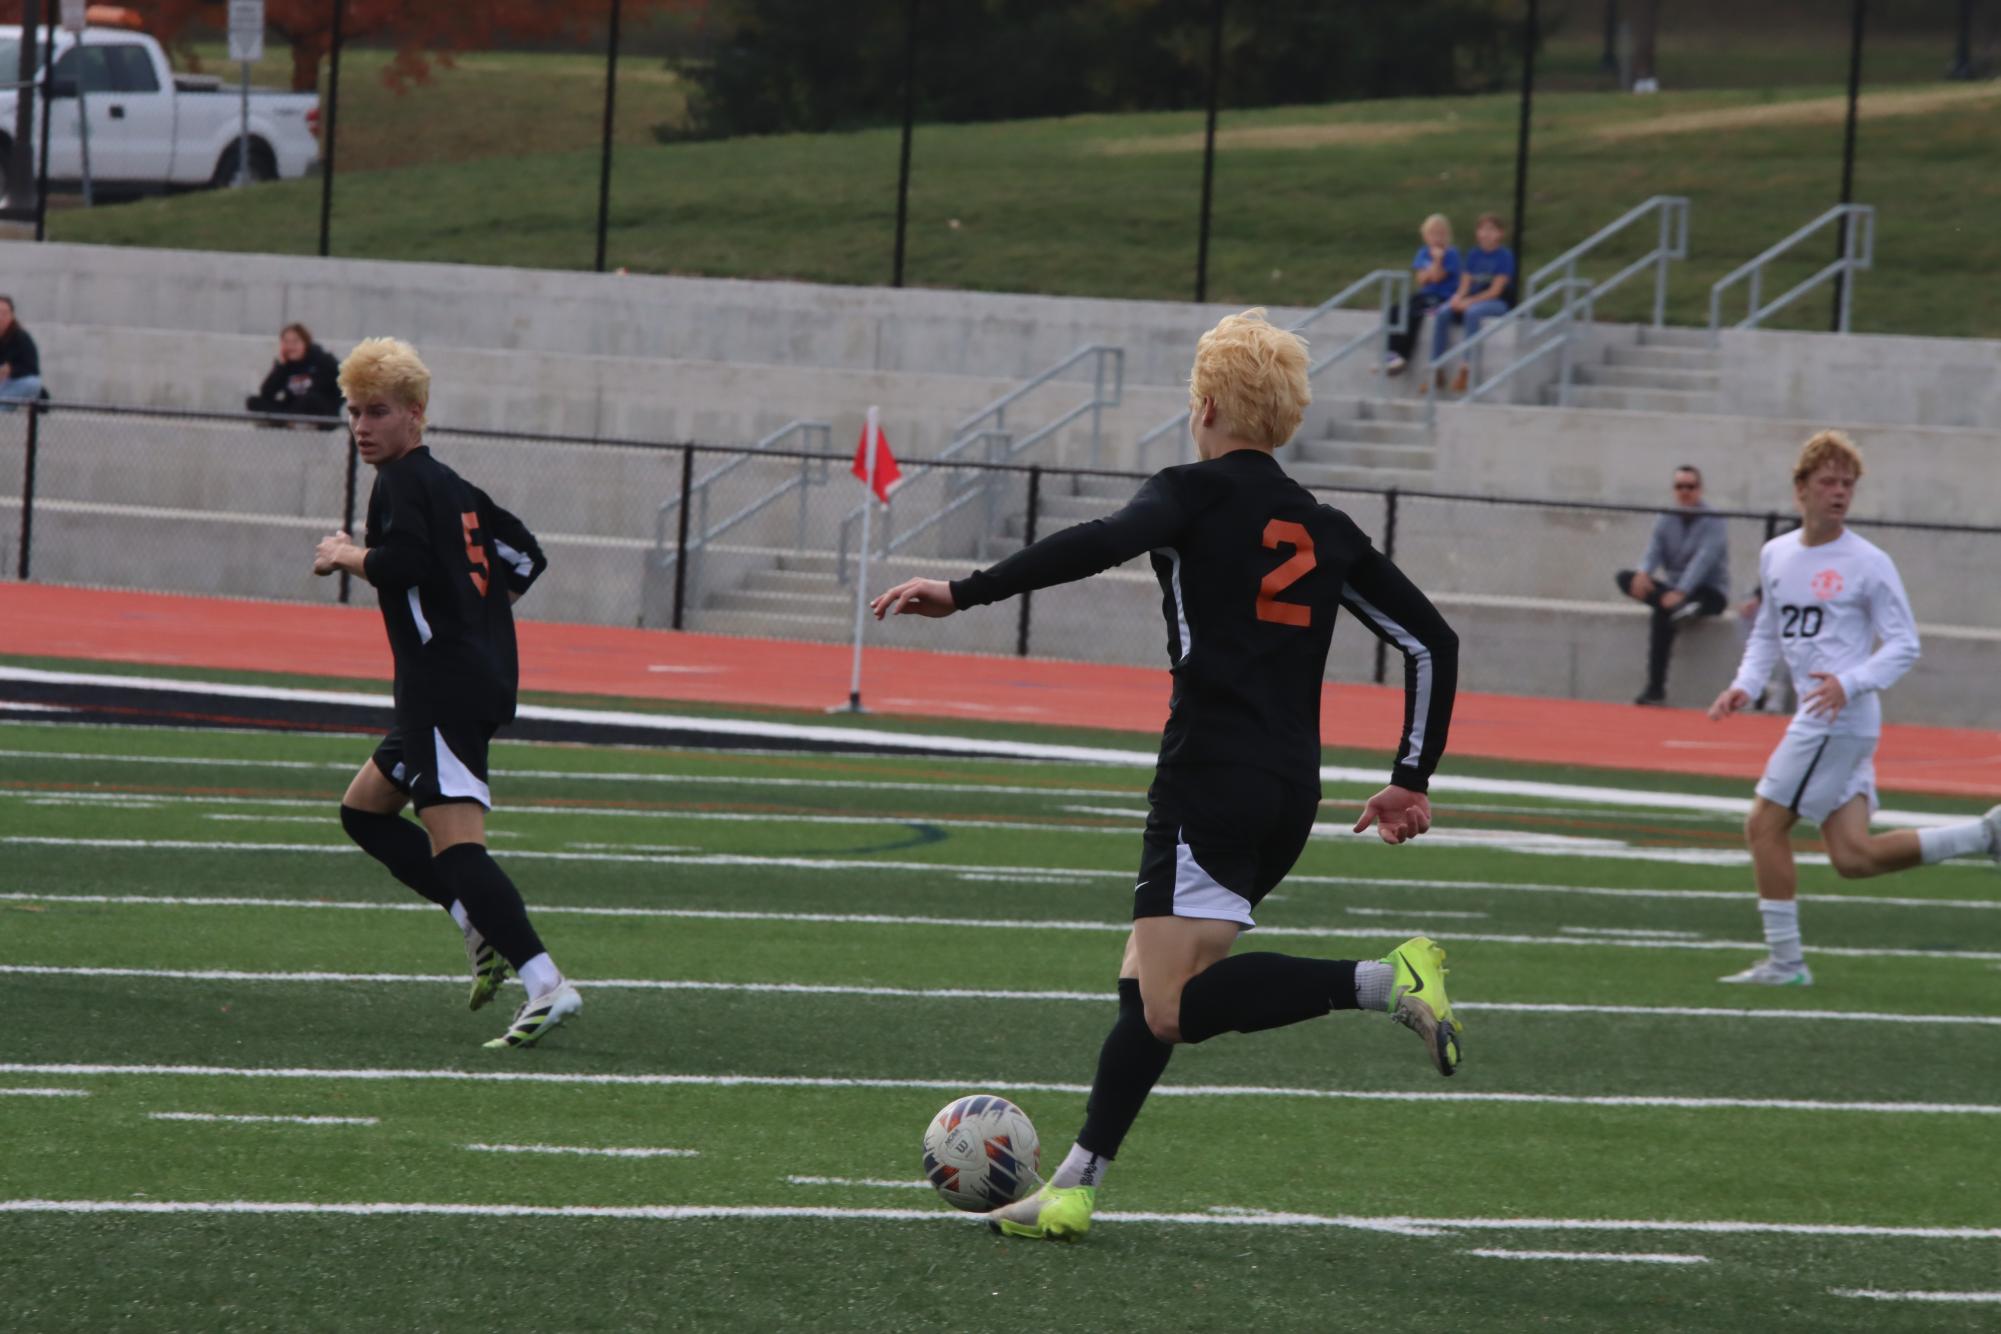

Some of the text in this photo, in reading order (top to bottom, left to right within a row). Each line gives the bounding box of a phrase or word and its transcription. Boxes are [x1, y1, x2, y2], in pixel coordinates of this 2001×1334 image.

[461, 511, 490, 597] 5
[1256, 518, 1317, 627] 2
[1781, 604, 1823, 638] 20
